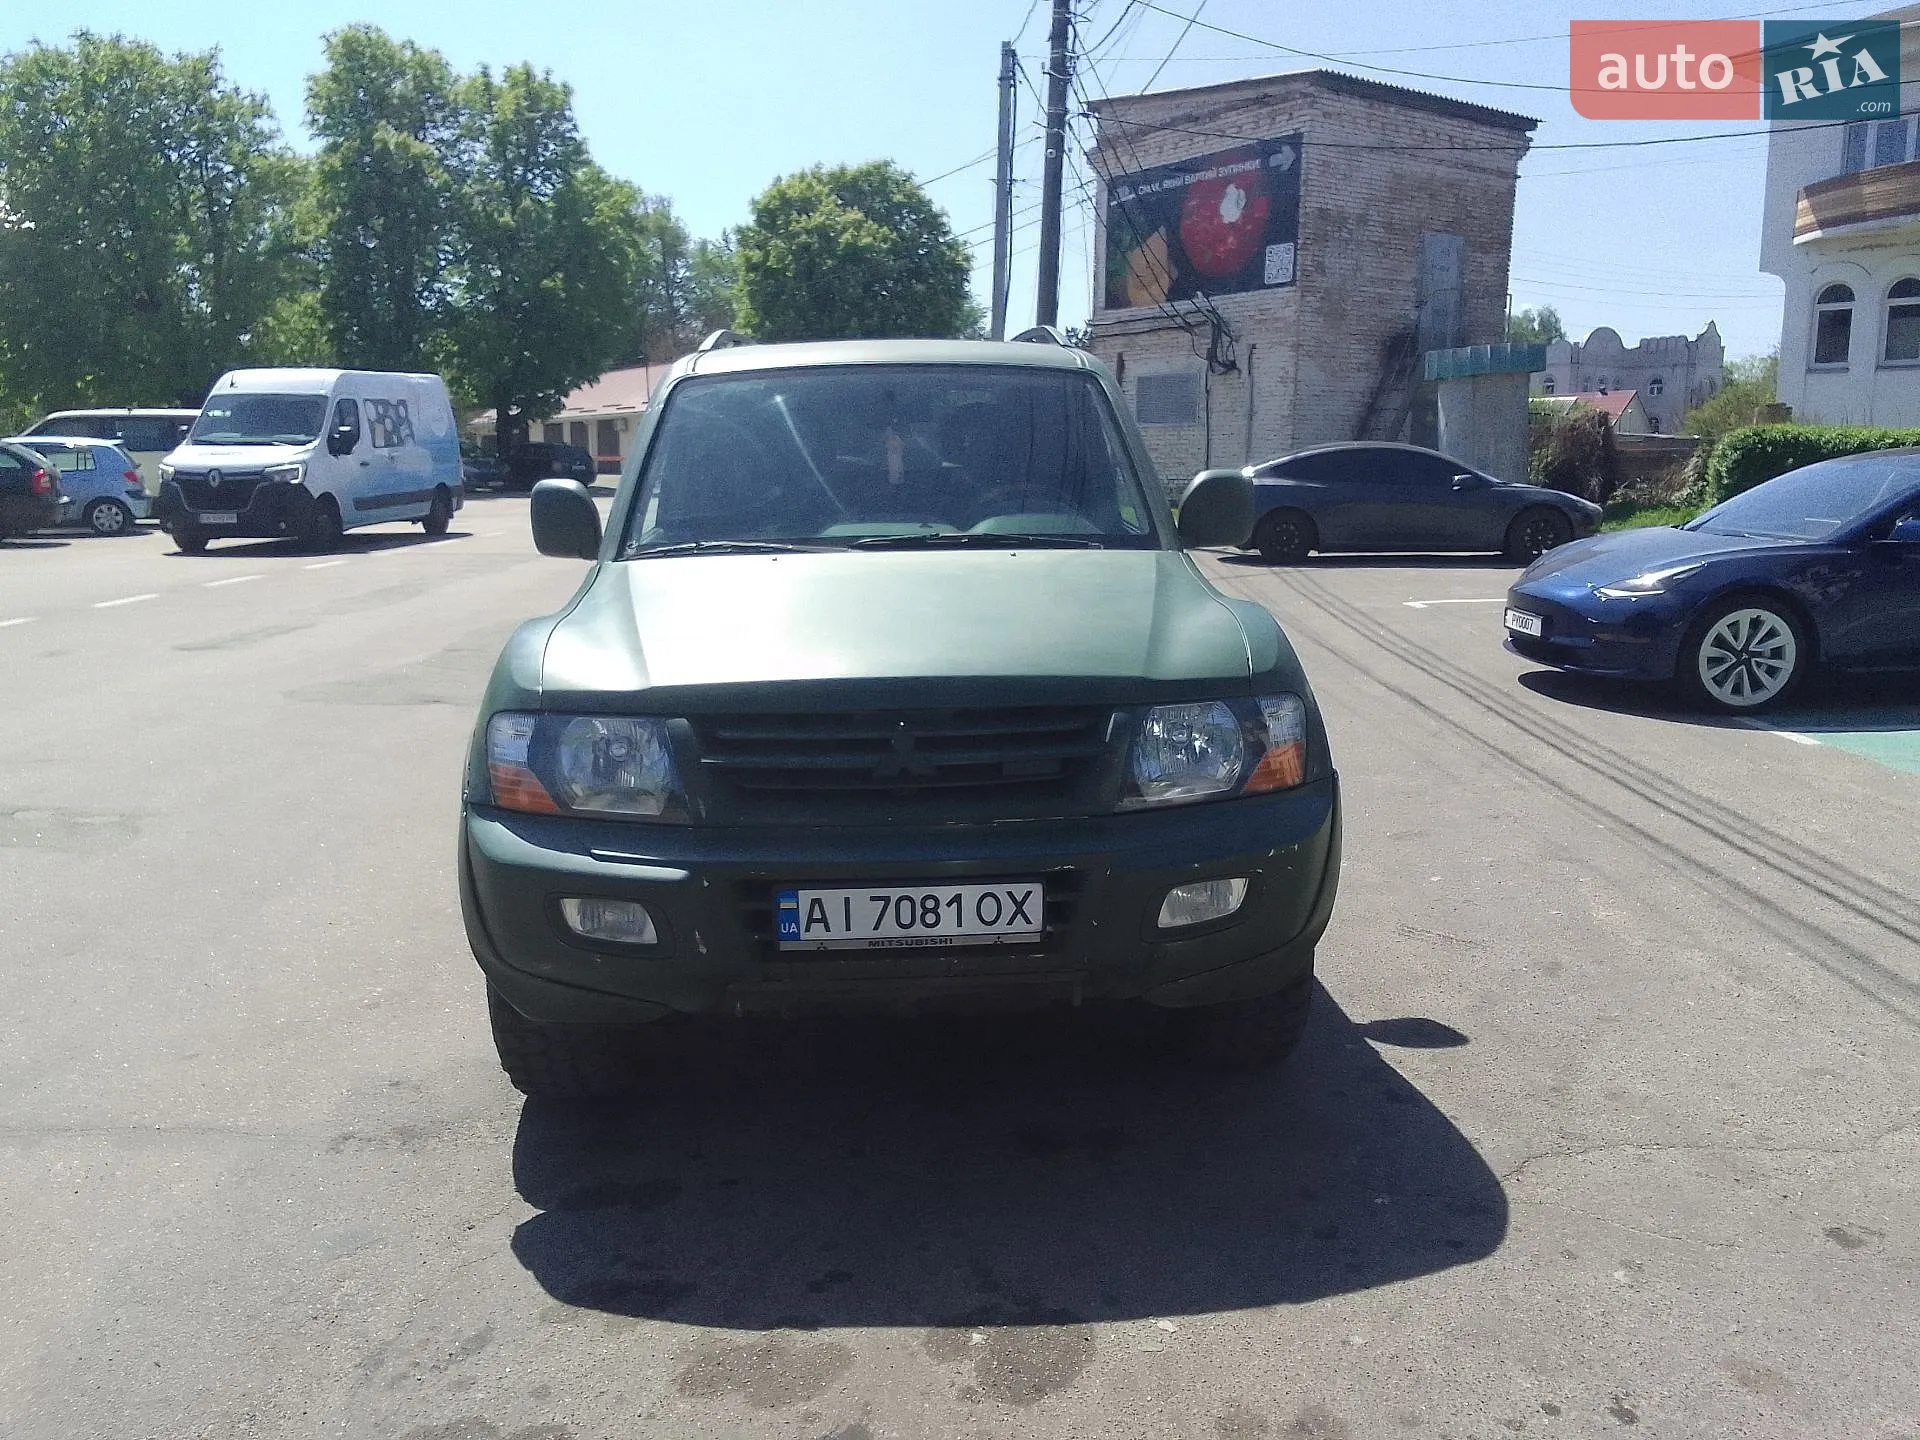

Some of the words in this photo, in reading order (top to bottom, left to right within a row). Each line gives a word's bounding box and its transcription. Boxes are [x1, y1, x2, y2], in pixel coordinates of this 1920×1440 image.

[804, 896, 852, 933] AI
[870, 892, 964, 931] 7081
[976, 890, 1033, 927] OX
[781, 924, 798, 934] UA
[868, 938, 953, 947] MITSUBISHI
